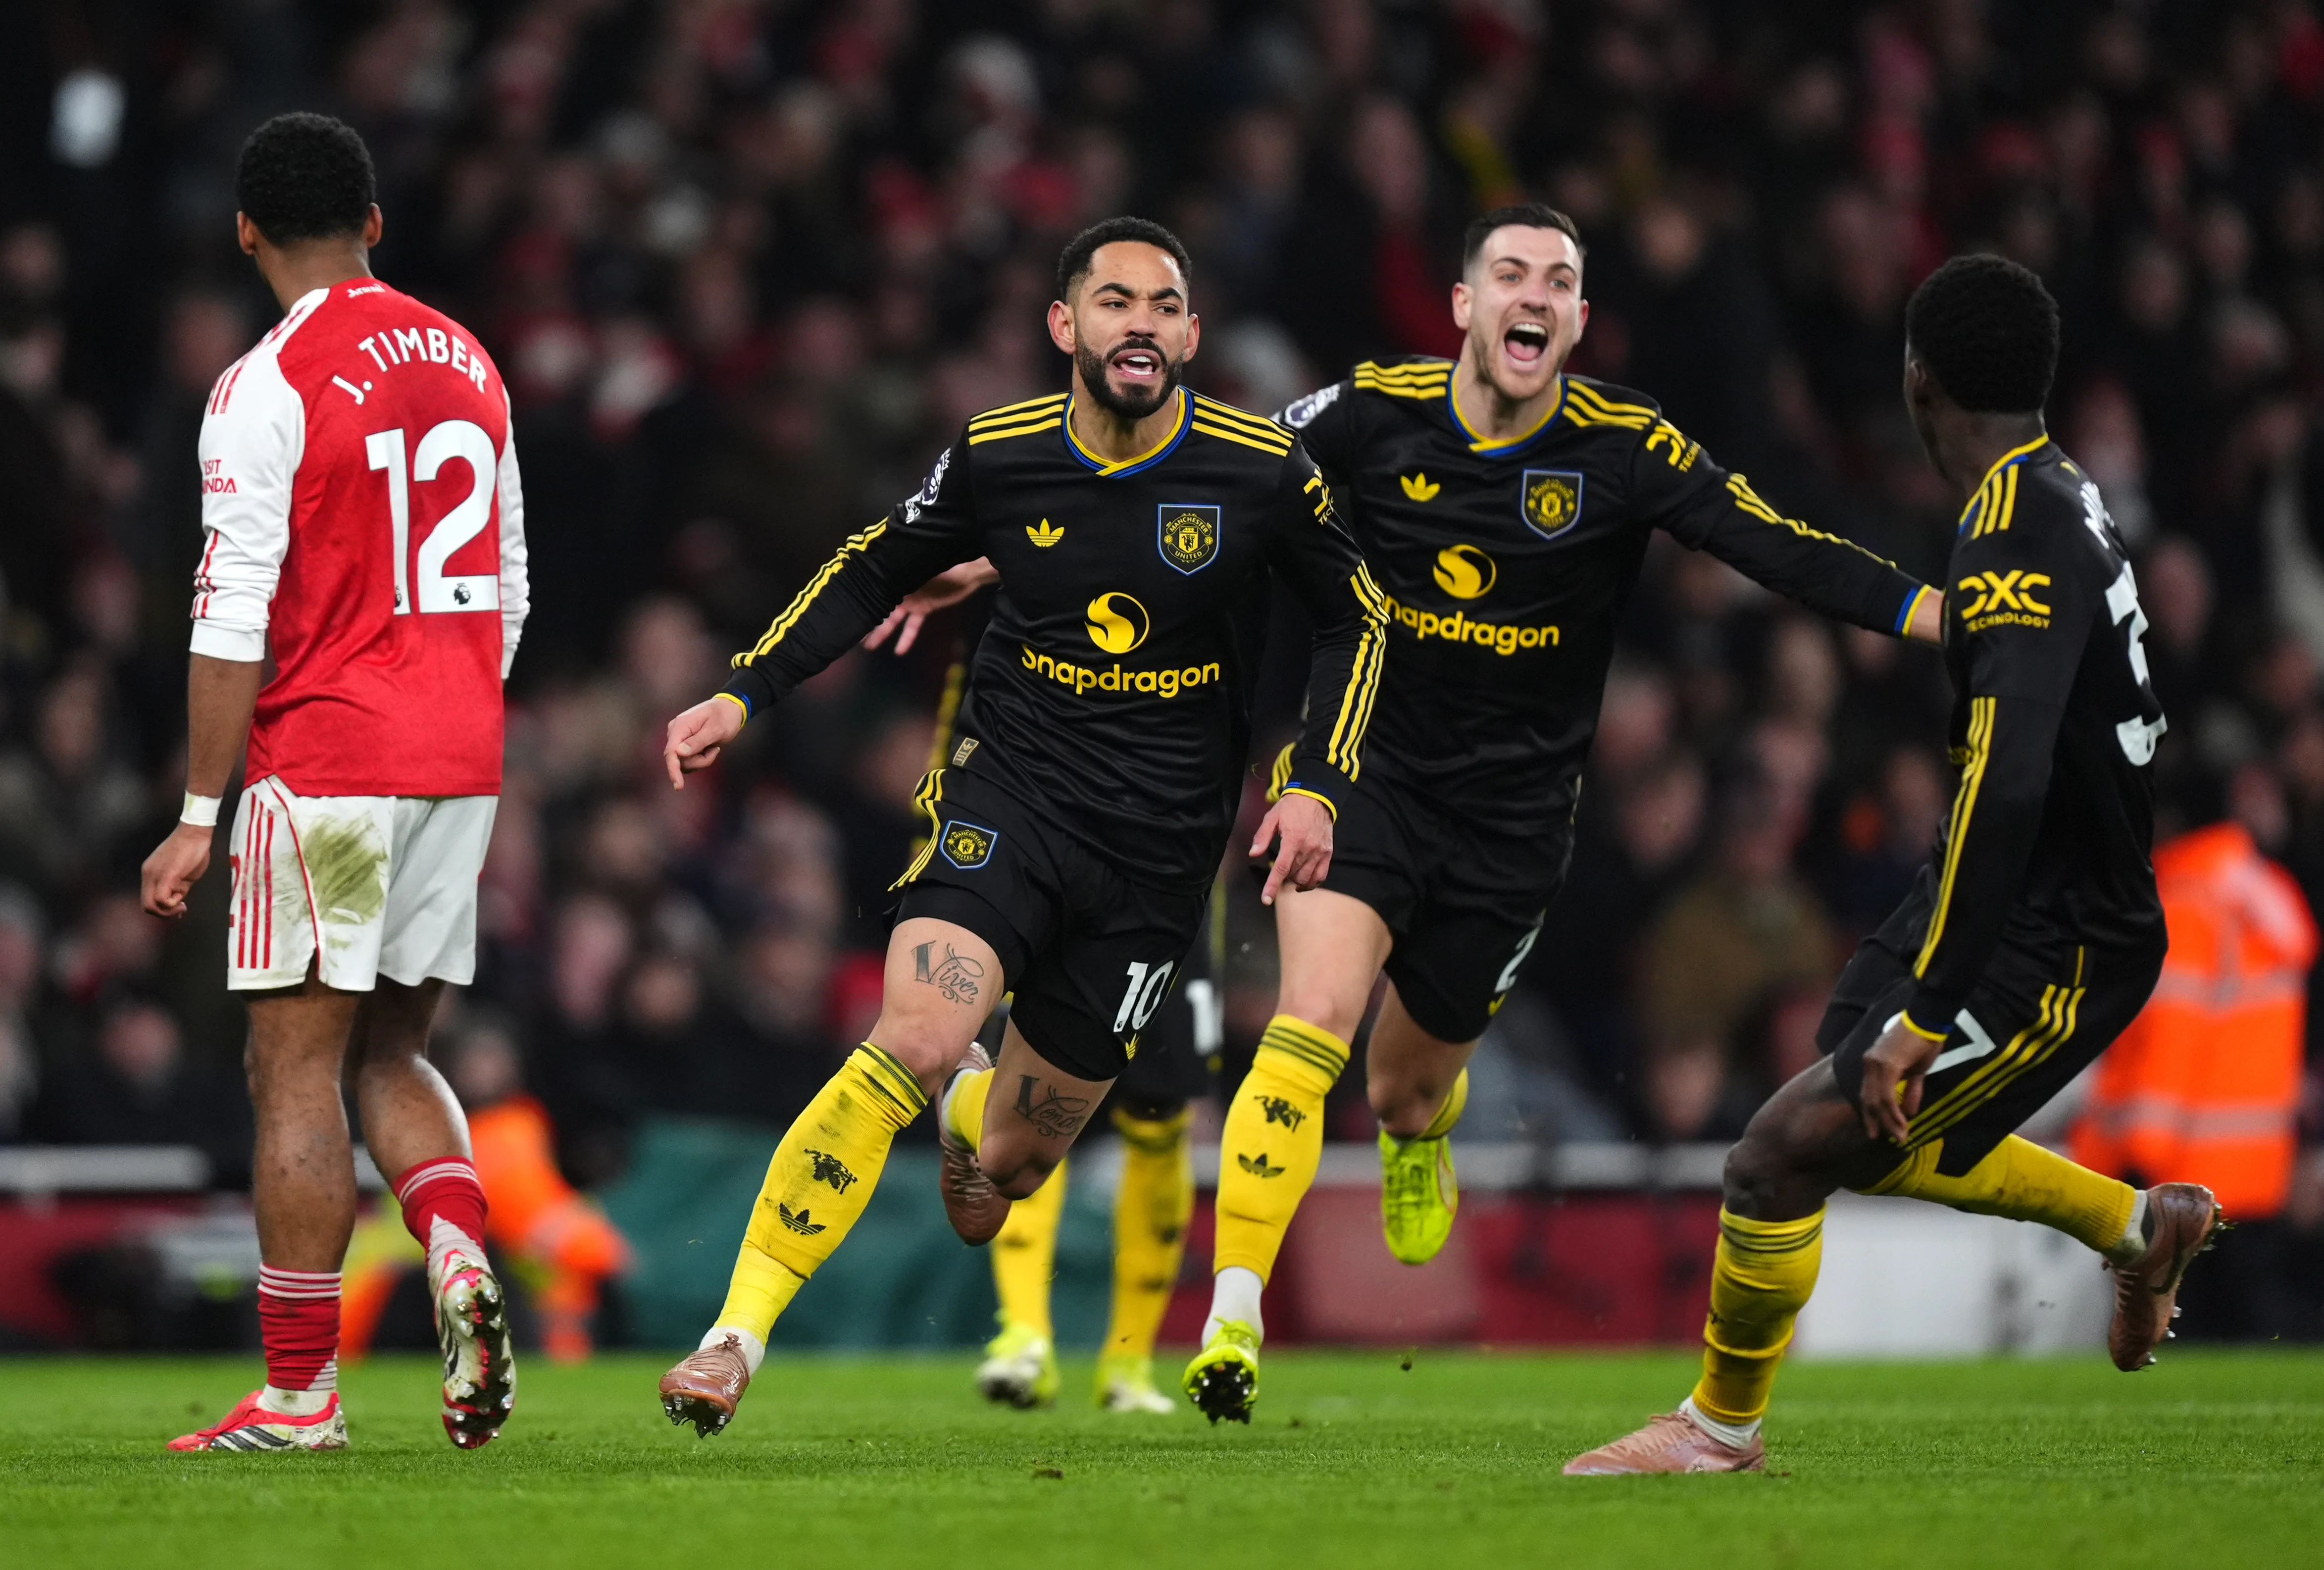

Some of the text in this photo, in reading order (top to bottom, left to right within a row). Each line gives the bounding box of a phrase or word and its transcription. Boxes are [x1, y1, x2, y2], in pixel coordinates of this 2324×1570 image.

[332, 326, 488, 405] J. TIMBER
[365, 419, 501, 615] 12
[1169, 516, 1209, 534] MANCHESTER
[1175, 550, 1203, 559] UNITED
[1375, 580, 1561, 657] napdragon
[1958, 569, 2052, 621] DXC
[1966, 611, 2051, 633] TECHNOLOGY
[1021, 644, 1220, 699] Snapdragon
[953, 849, 974, 860] UNITED
[954, 831, 984, 848] MANCHESTER
[1113, 960, 1174, 1033] 10
[1186, 978, 1224, 1056] 1
[1882, 1008, 1996, 1076] 7
